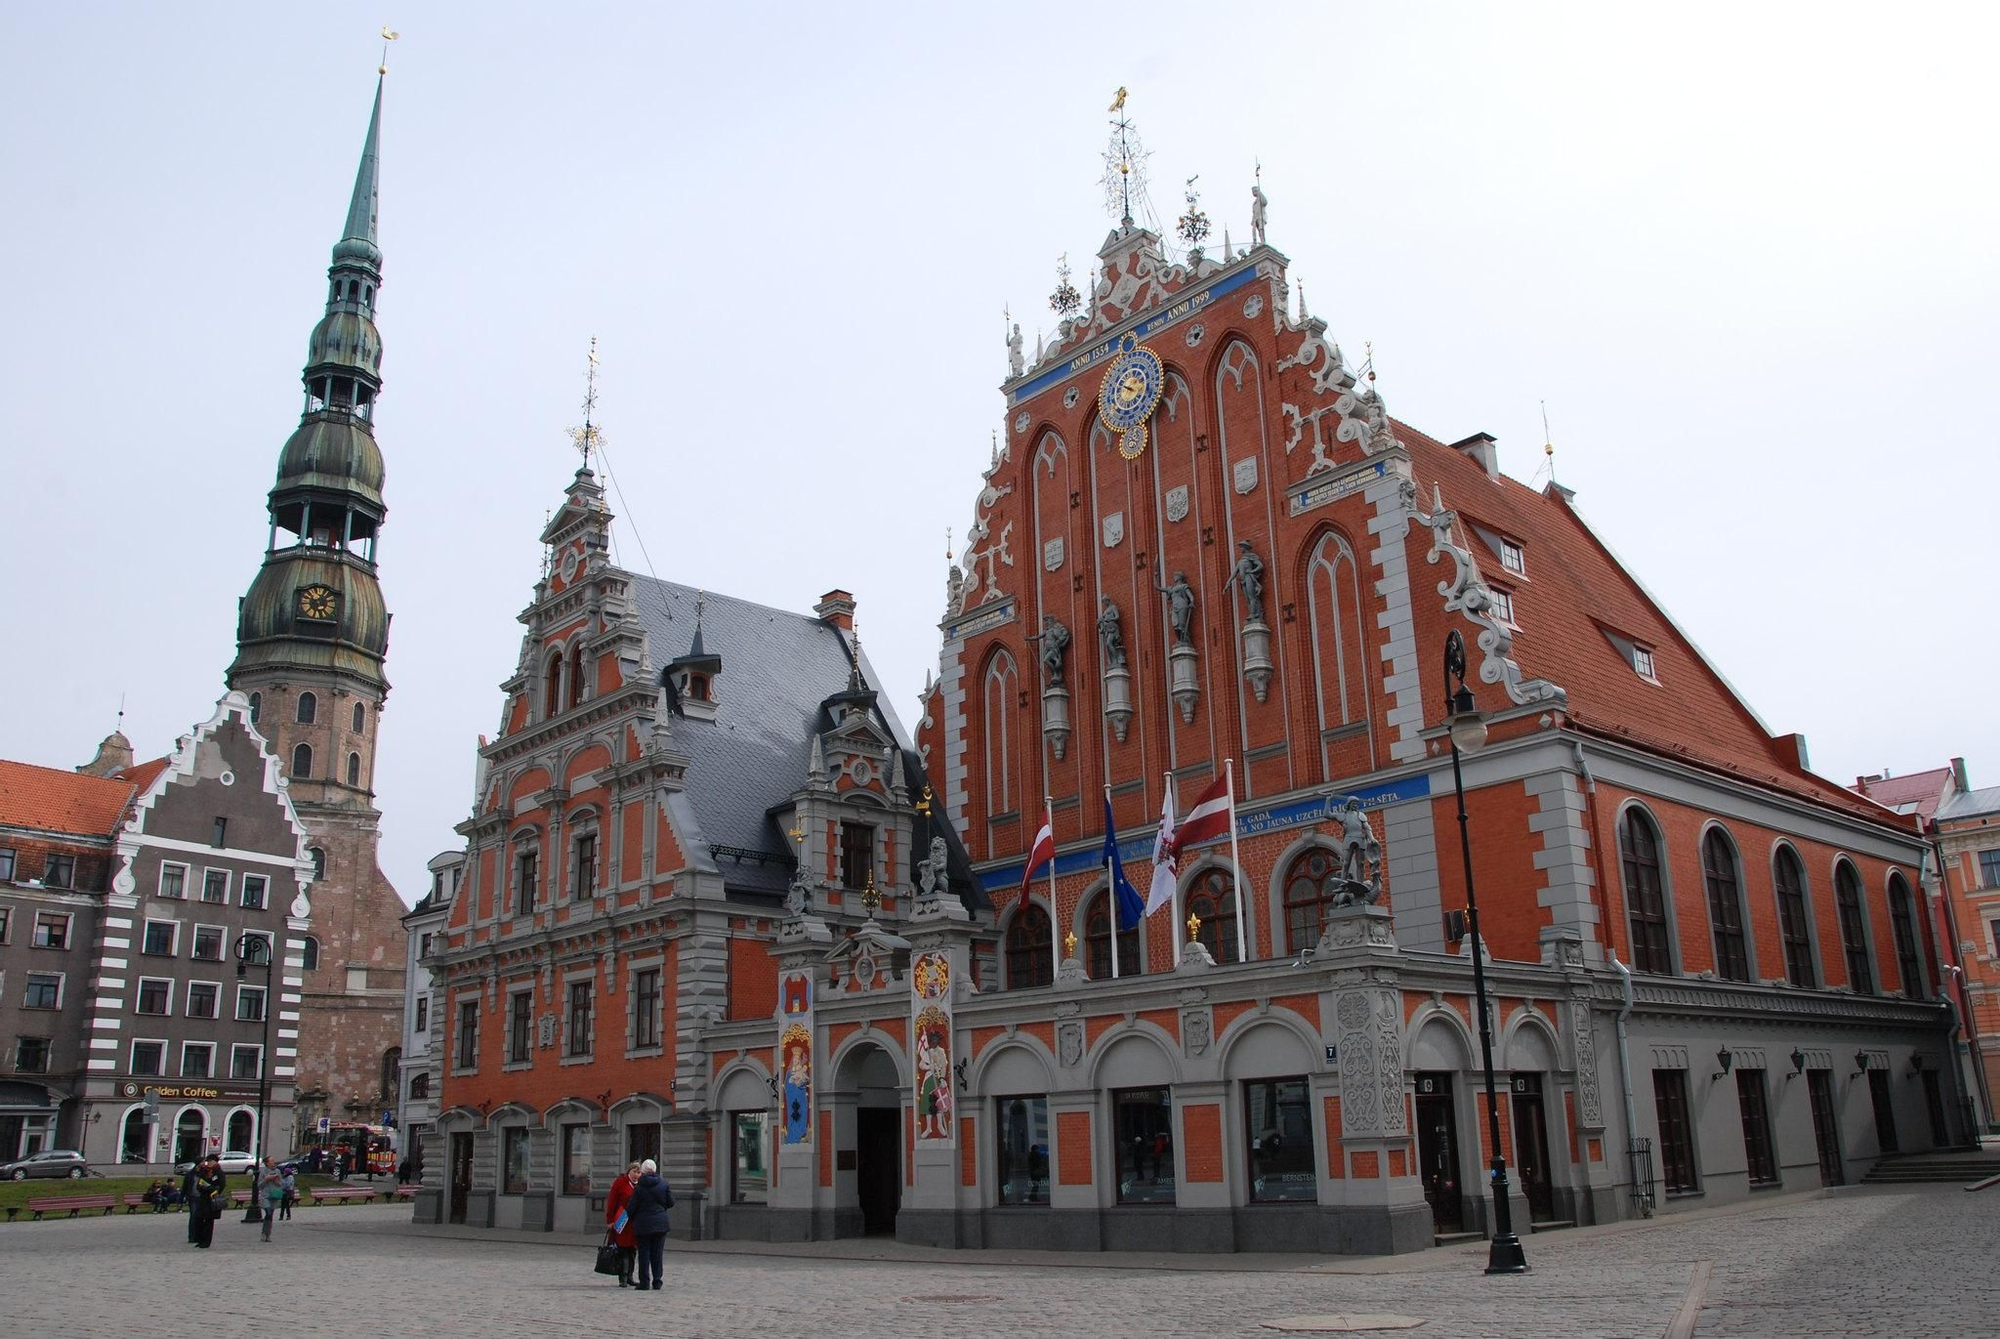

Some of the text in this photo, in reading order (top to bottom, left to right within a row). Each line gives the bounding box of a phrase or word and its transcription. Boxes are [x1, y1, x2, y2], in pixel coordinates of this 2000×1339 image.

[1070, 353, 1090, 372] ANNO
[1092, 343, 1110, 361] 1334
[1167, 301, 1189, 321] ANNO
[1192, 290, 1210, 308] 1999
[1250, 822, 1264, 832] NO
[1267, 815, 1293, 829] JAUNA
[1328, 1048, 1334, 1057] 7
[183, 1087, 217, 1098] Coffee
